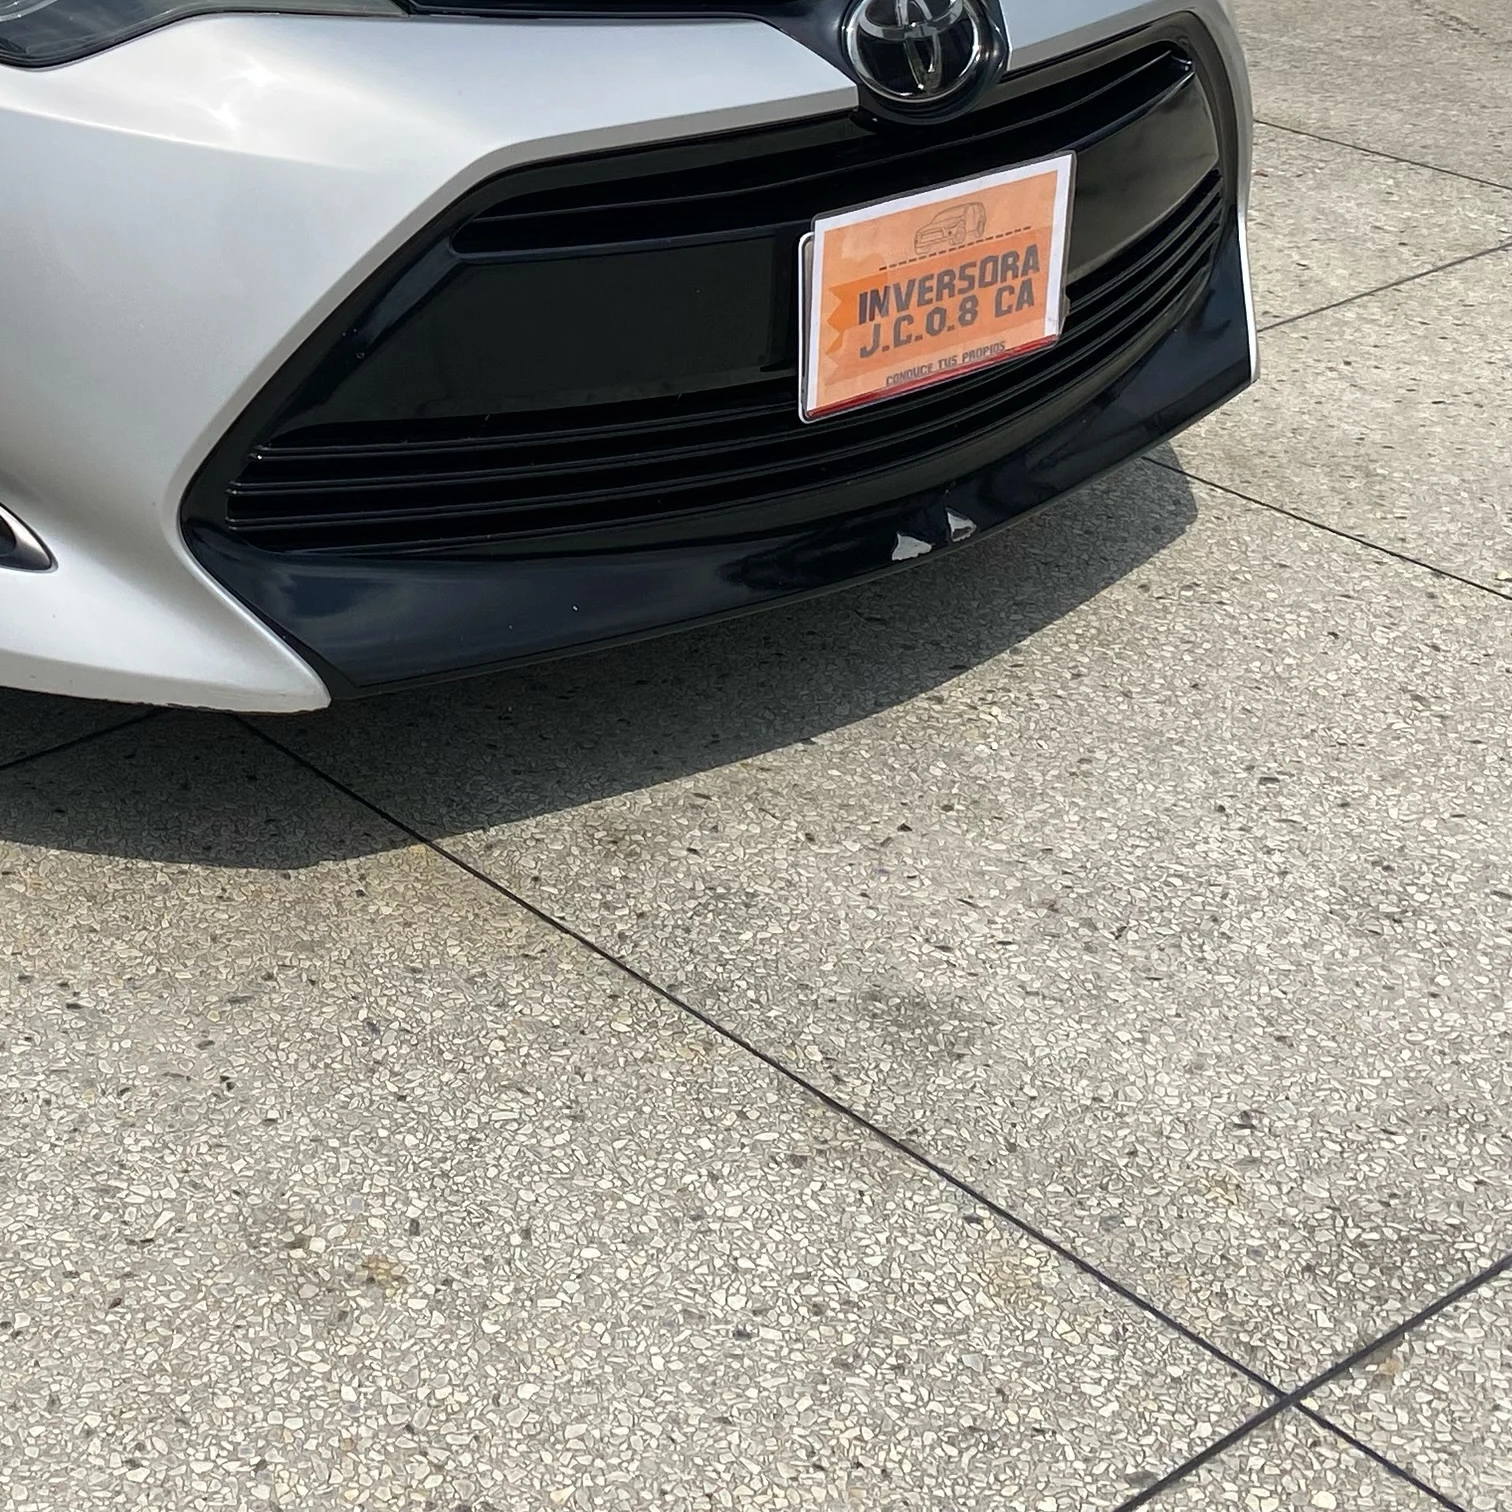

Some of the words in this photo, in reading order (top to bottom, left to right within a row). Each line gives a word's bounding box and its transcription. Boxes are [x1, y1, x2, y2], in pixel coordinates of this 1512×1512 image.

[858, 243, 1041, 326] INVERSORA
[994, 277, 1035, 319] CA
[885, 362, 934, 388] CONDUCE
[938, 354, 958, 370] TUS
[961, 340, 1006, 365] PROPIOS
